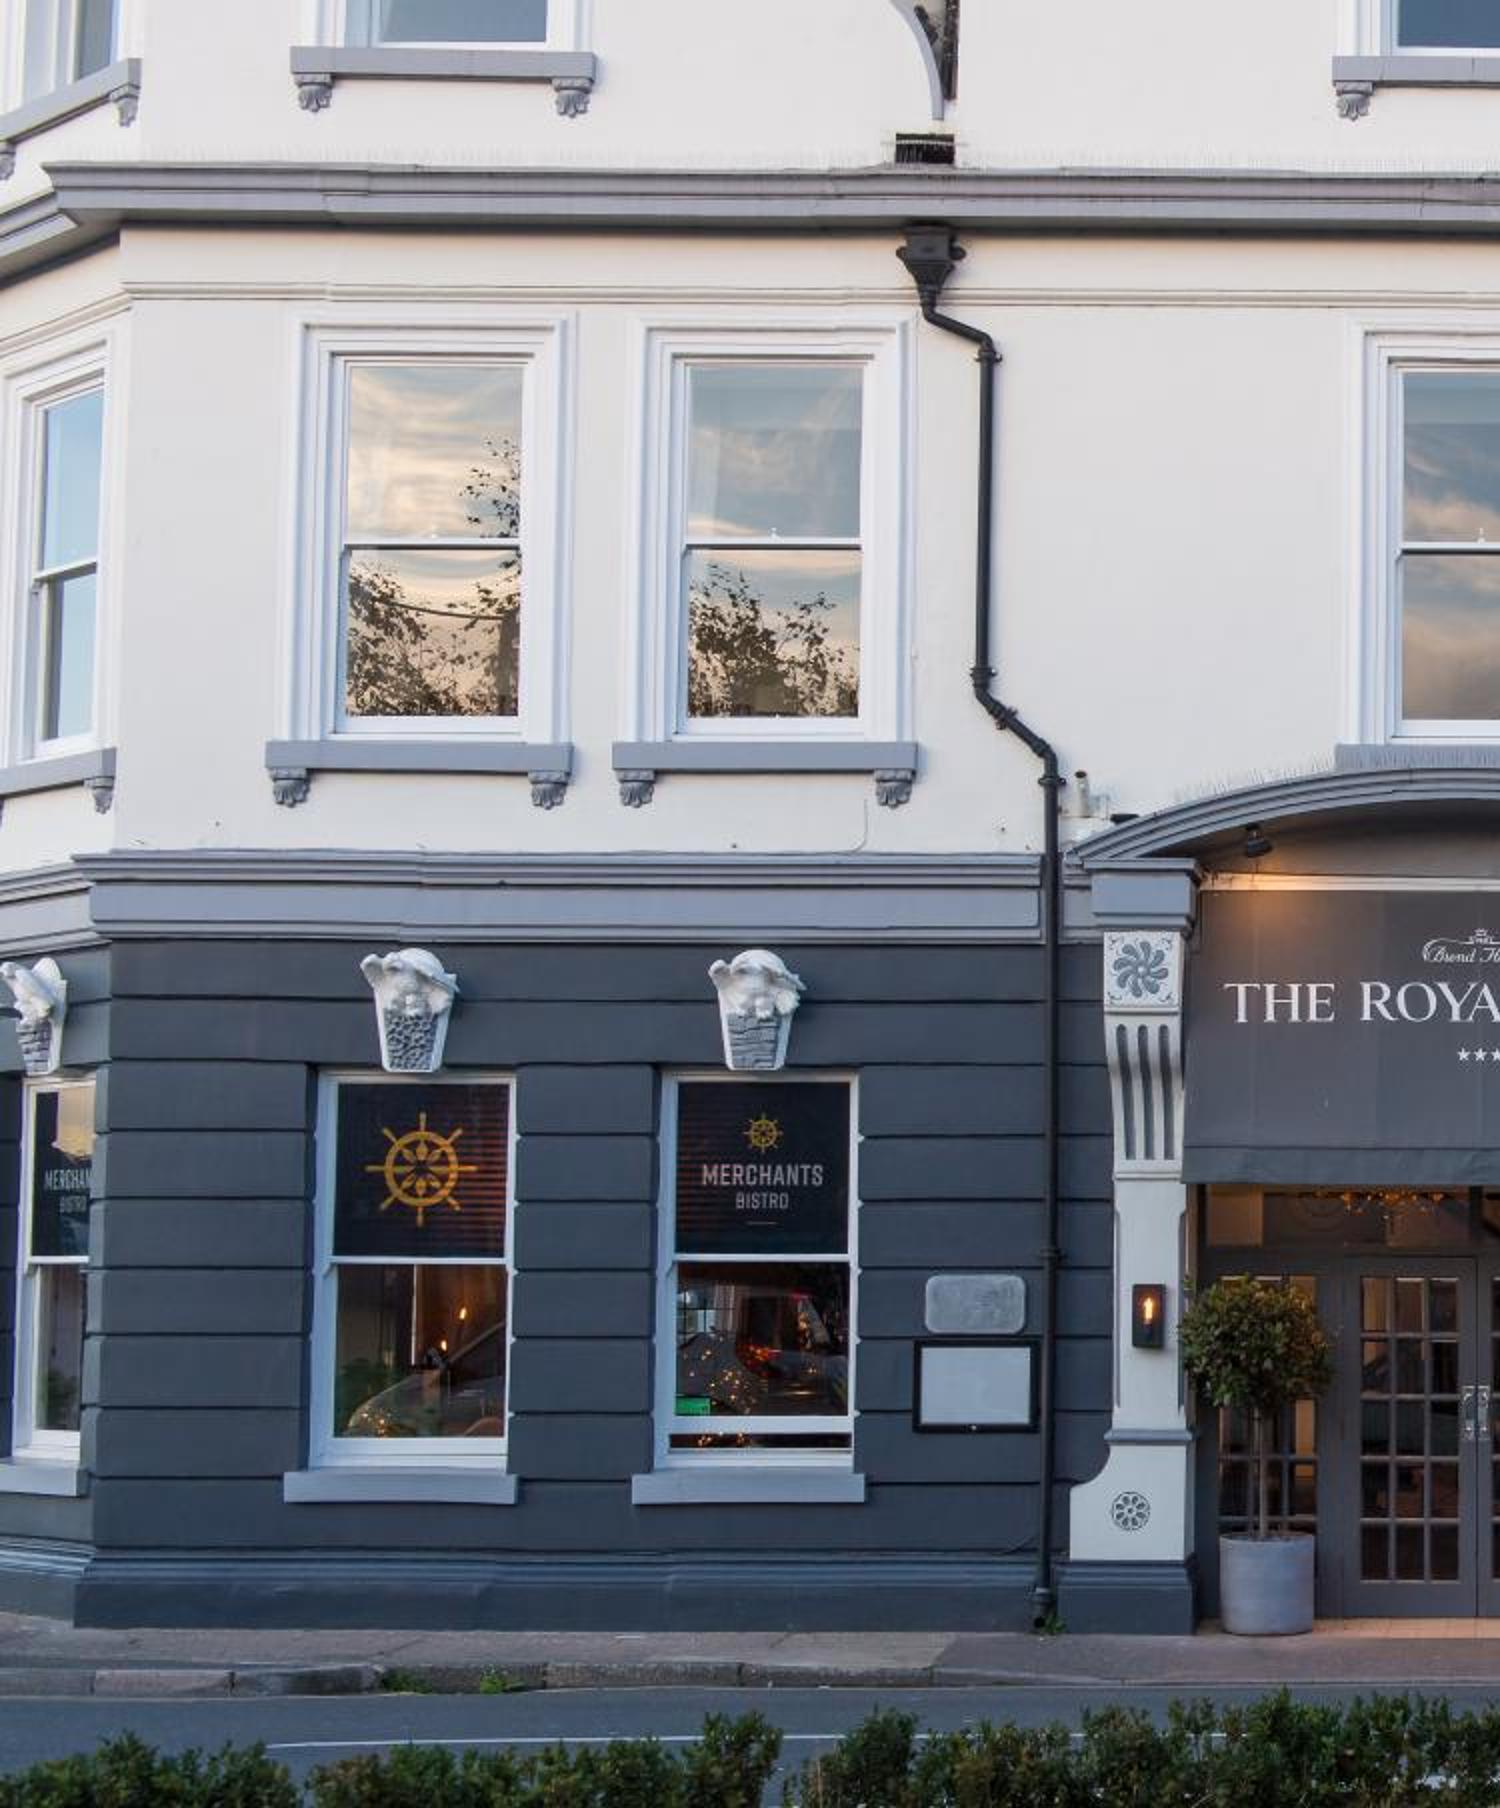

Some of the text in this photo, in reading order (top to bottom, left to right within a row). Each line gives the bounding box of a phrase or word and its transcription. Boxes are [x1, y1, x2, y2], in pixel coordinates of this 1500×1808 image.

[1223, 983, 1335, 1023] THE
[702, 1163, 823, 1186] MERCHANTS
[735, 1191, 789, 1209] BISTRO
